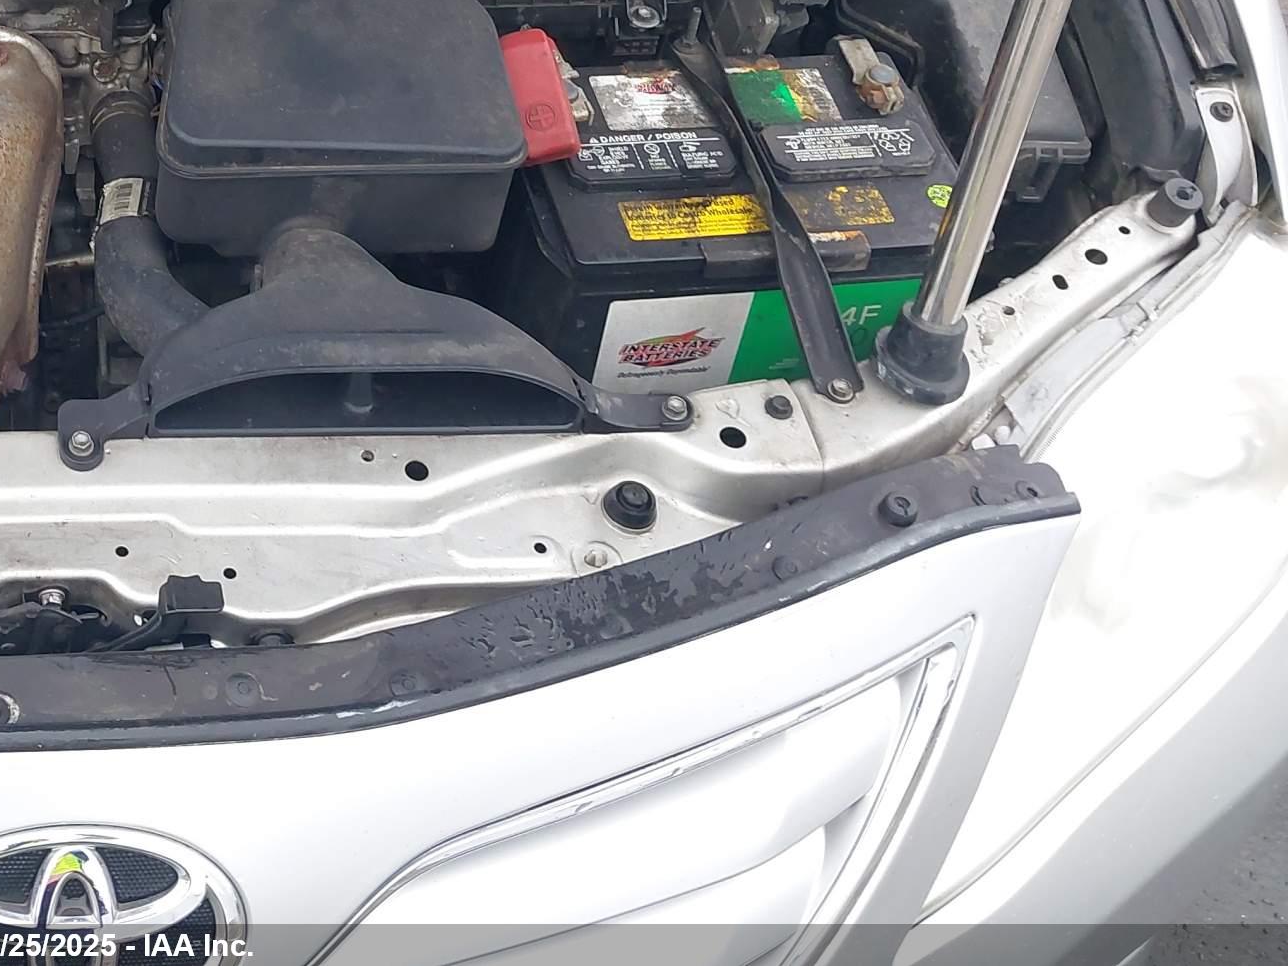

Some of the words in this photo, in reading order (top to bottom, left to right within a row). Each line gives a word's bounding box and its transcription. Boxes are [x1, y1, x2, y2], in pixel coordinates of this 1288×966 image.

[599, 134, 645, 143] DANGER
[655, 131, 697, 140] POISON
[619, 337, 725, 355] INTERSTATE
[618, 349, 710, 364] BATTERIES
